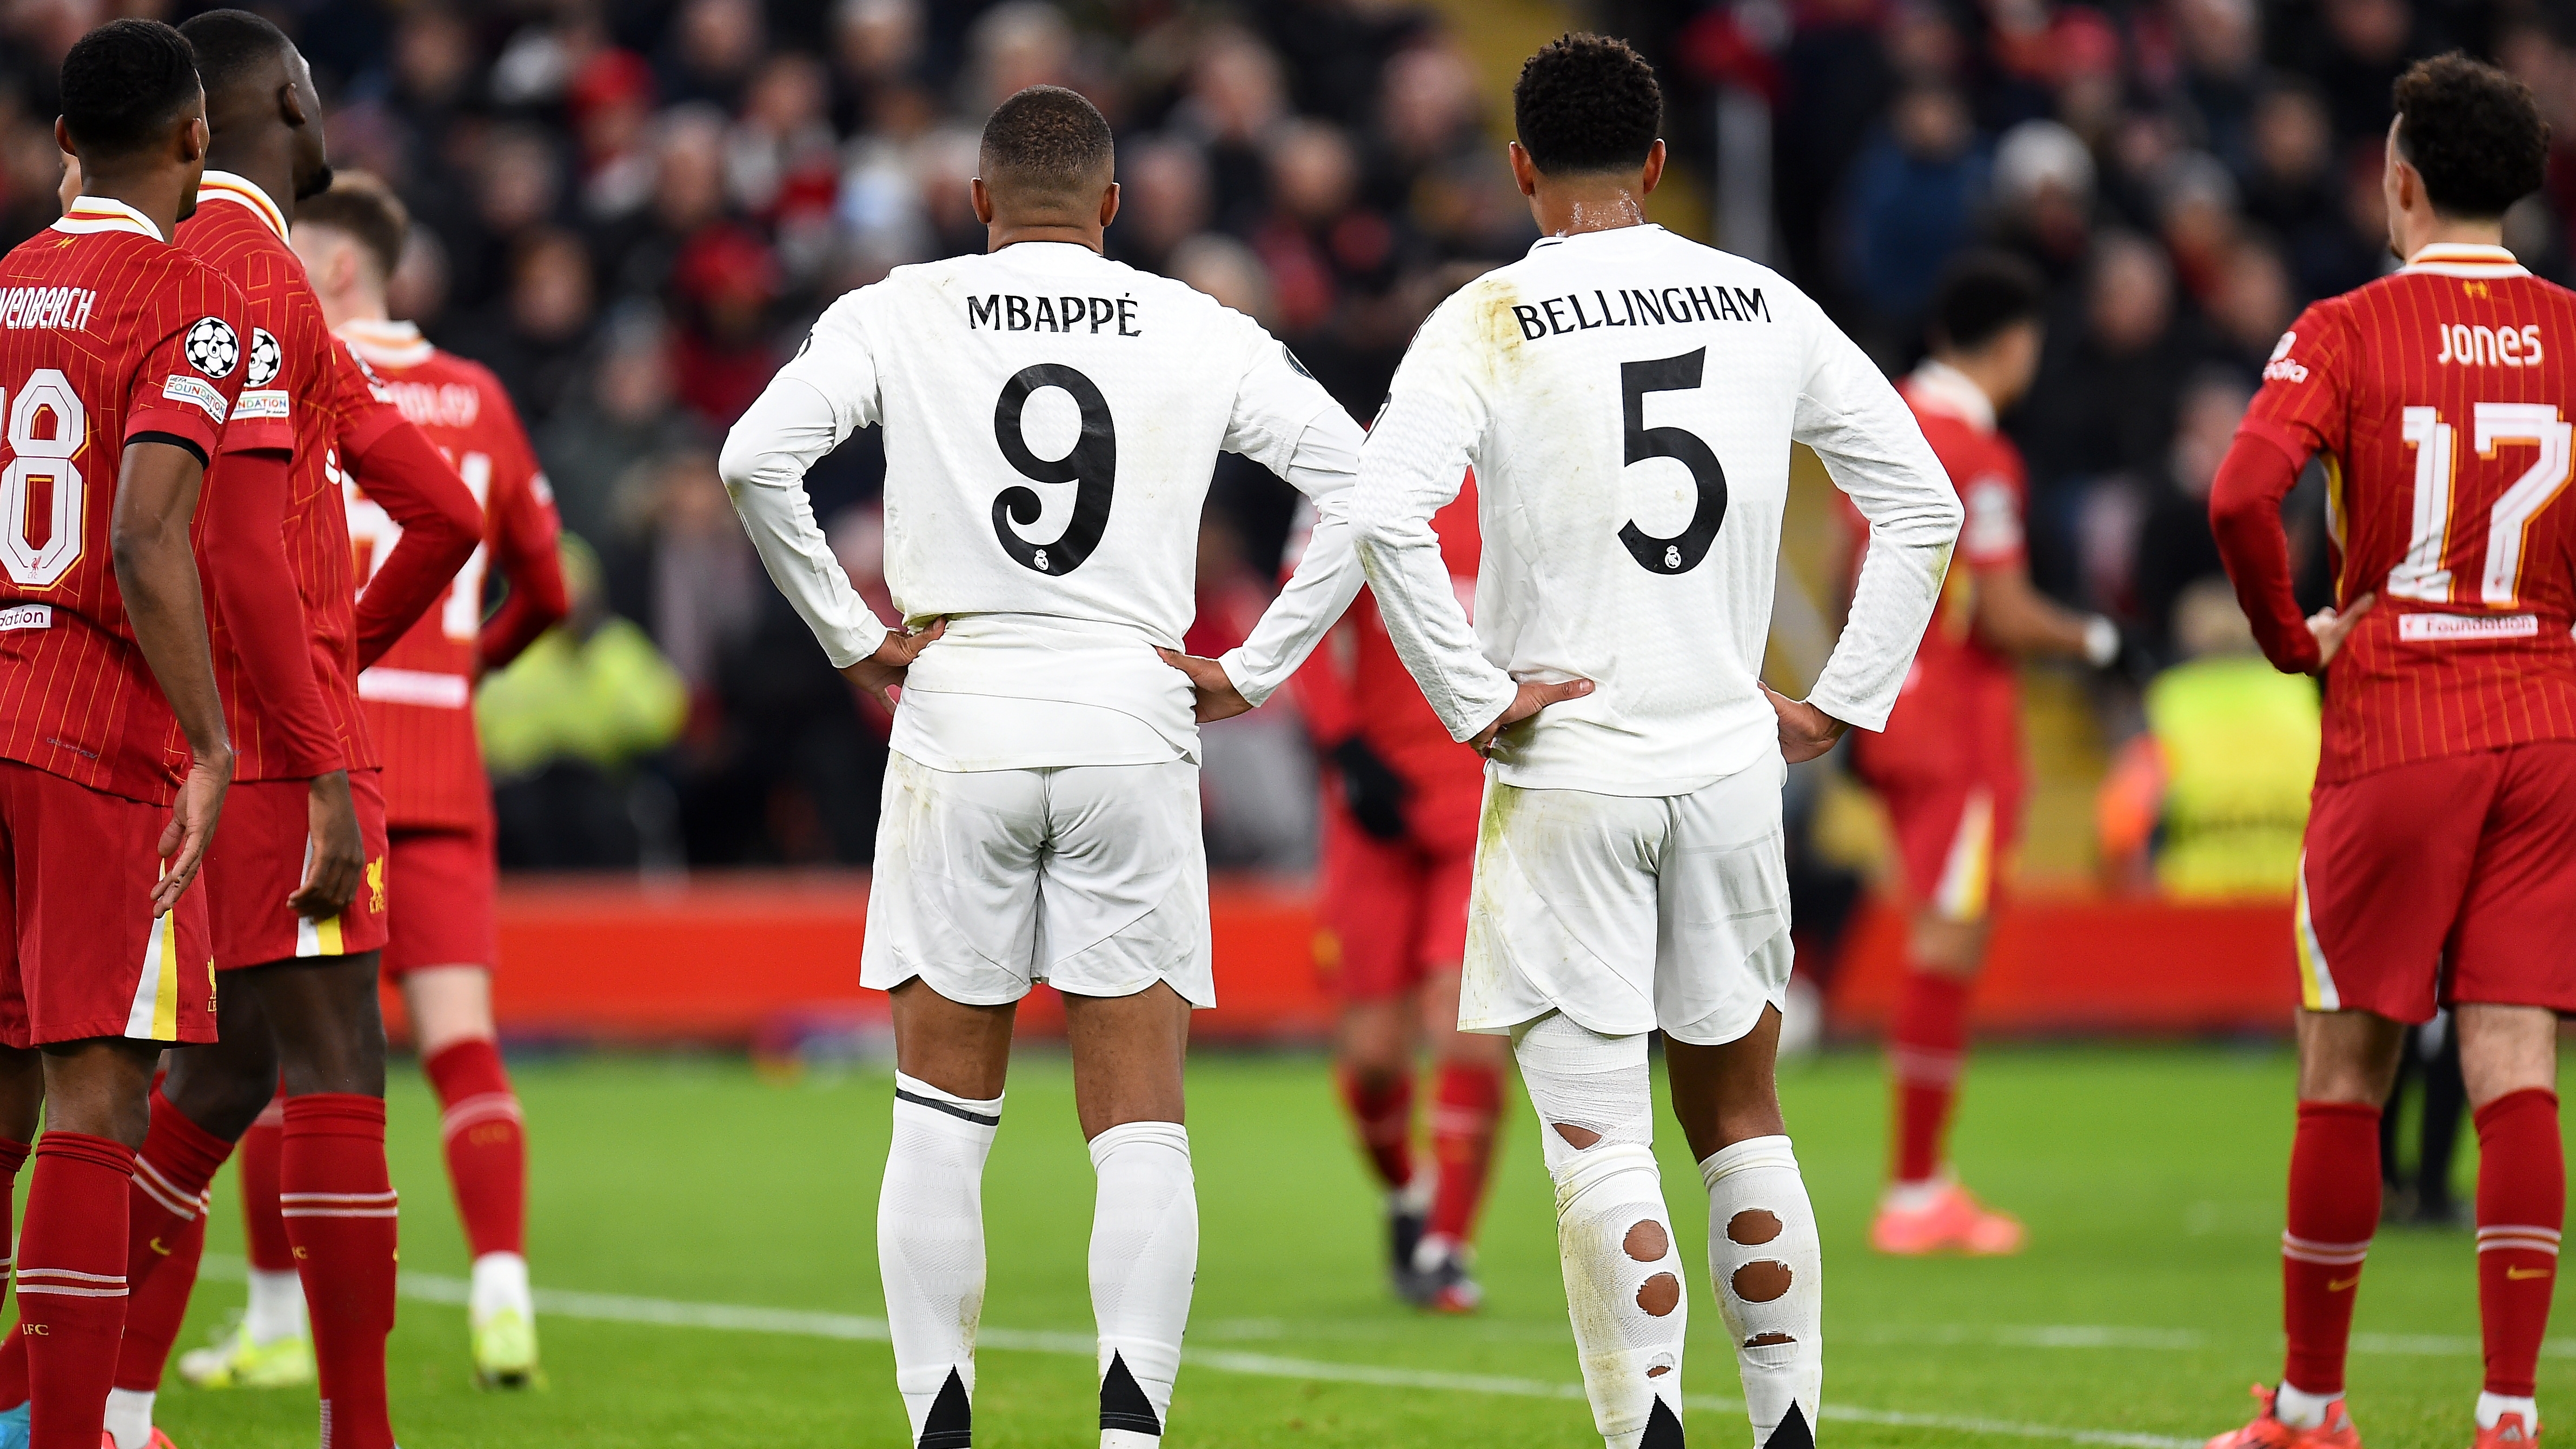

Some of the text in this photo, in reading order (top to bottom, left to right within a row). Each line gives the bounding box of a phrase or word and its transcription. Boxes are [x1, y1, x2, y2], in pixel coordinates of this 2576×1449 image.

[0, 287, 96, 332] VENBERCH
[967, 293, 1143, 337] MBAPPÉ
[1511, 285, 1771, 341] BELLINGHAM
[2438, 324, 2543, 367] JONES
[167, 382, 224, 416] FOUNDATION
[235, 397, 286, 409] NDATION
[0, 369, 85, 587] 8
[992, 363, 1116, 576] 9
[1617, 345, 1727, 575] 5
[2387, 402, 2575, 606] 17
[2427, 615, 2533, 633] Foundation
[22, 1323, 49, 1335] LFC
